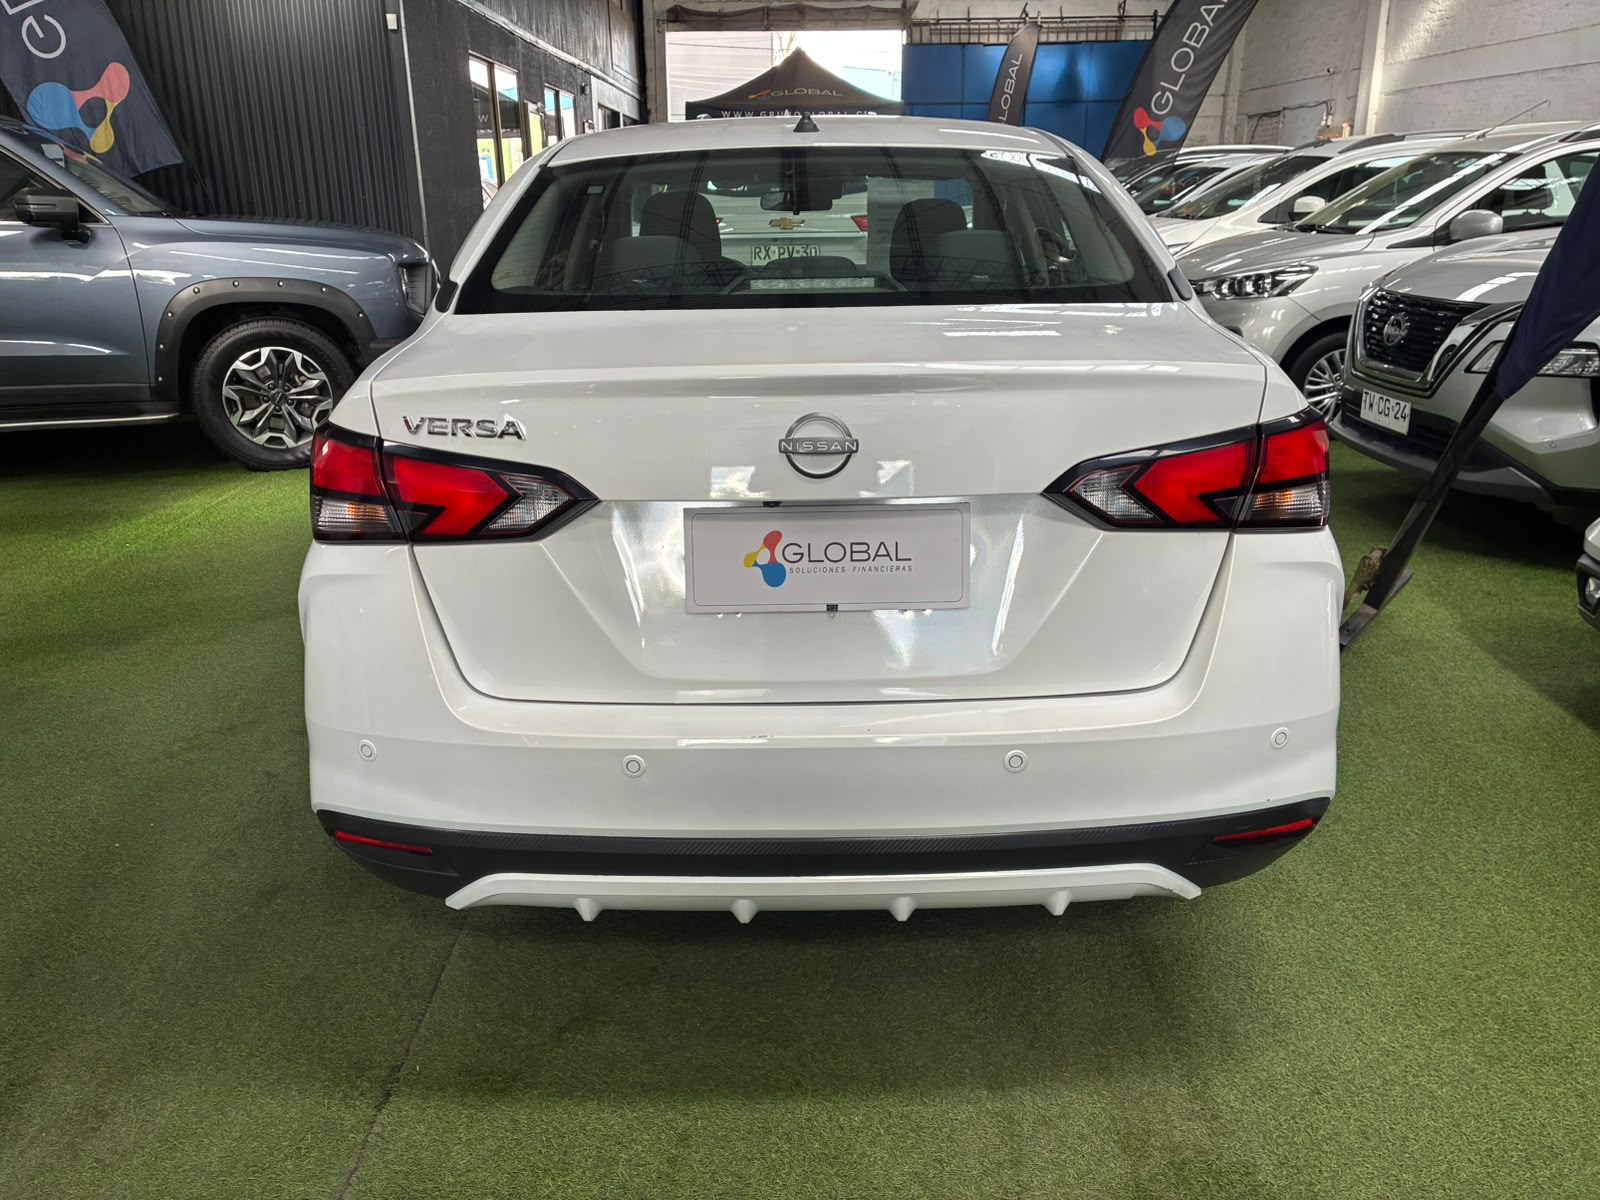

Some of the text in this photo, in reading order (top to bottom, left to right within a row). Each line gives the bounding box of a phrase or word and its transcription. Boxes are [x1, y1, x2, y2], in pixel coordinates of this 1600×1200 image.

[1151, 0, 1228, 115] GLOBA
[771, 88, 843, 97] GLOBAL
[998, 53, 1022, 124] LOBAL
[402, 414, 527, 440] VERSA
[781, 441, 857, 451] NISSAN
[782, 541, 912, 564] GLOBAL
[789, 565, 913, 574] SOLUCIONES FINANCIERAS
